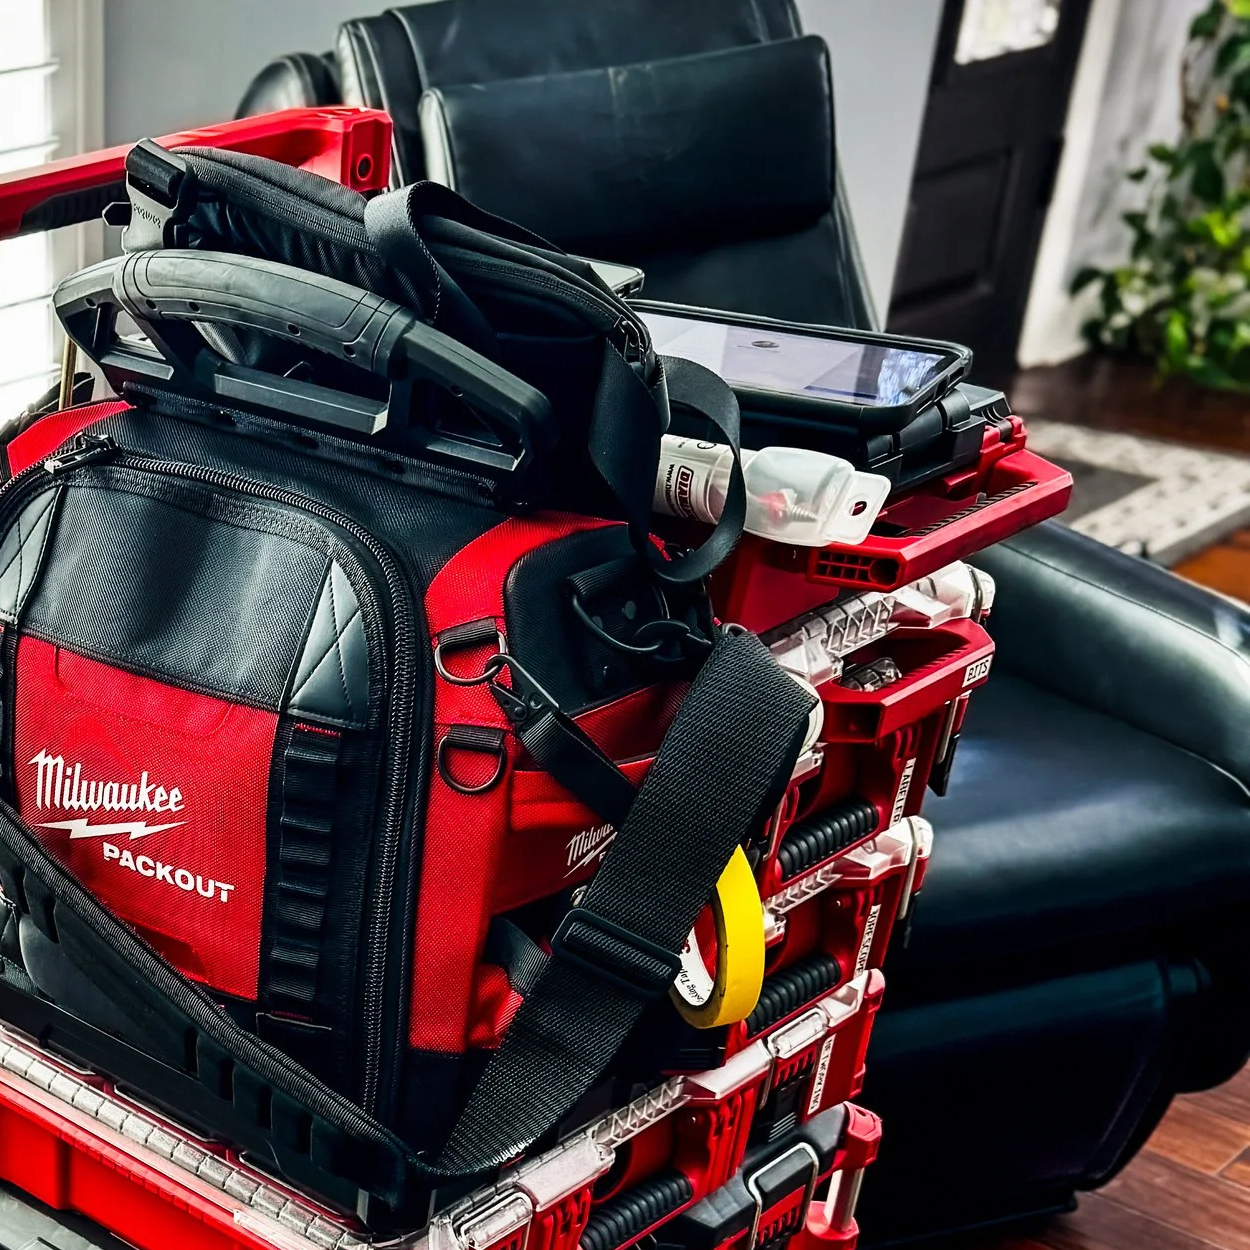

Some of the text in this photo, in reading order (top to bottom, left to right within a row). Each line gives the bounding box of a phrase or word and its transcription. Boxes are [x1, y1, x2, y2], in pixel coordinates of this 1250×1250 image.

[966, 659, 989, 682] BITS
[28, 748, 185, 812] Milwaukee
[103, 842, 235, 903] PACKOUT
